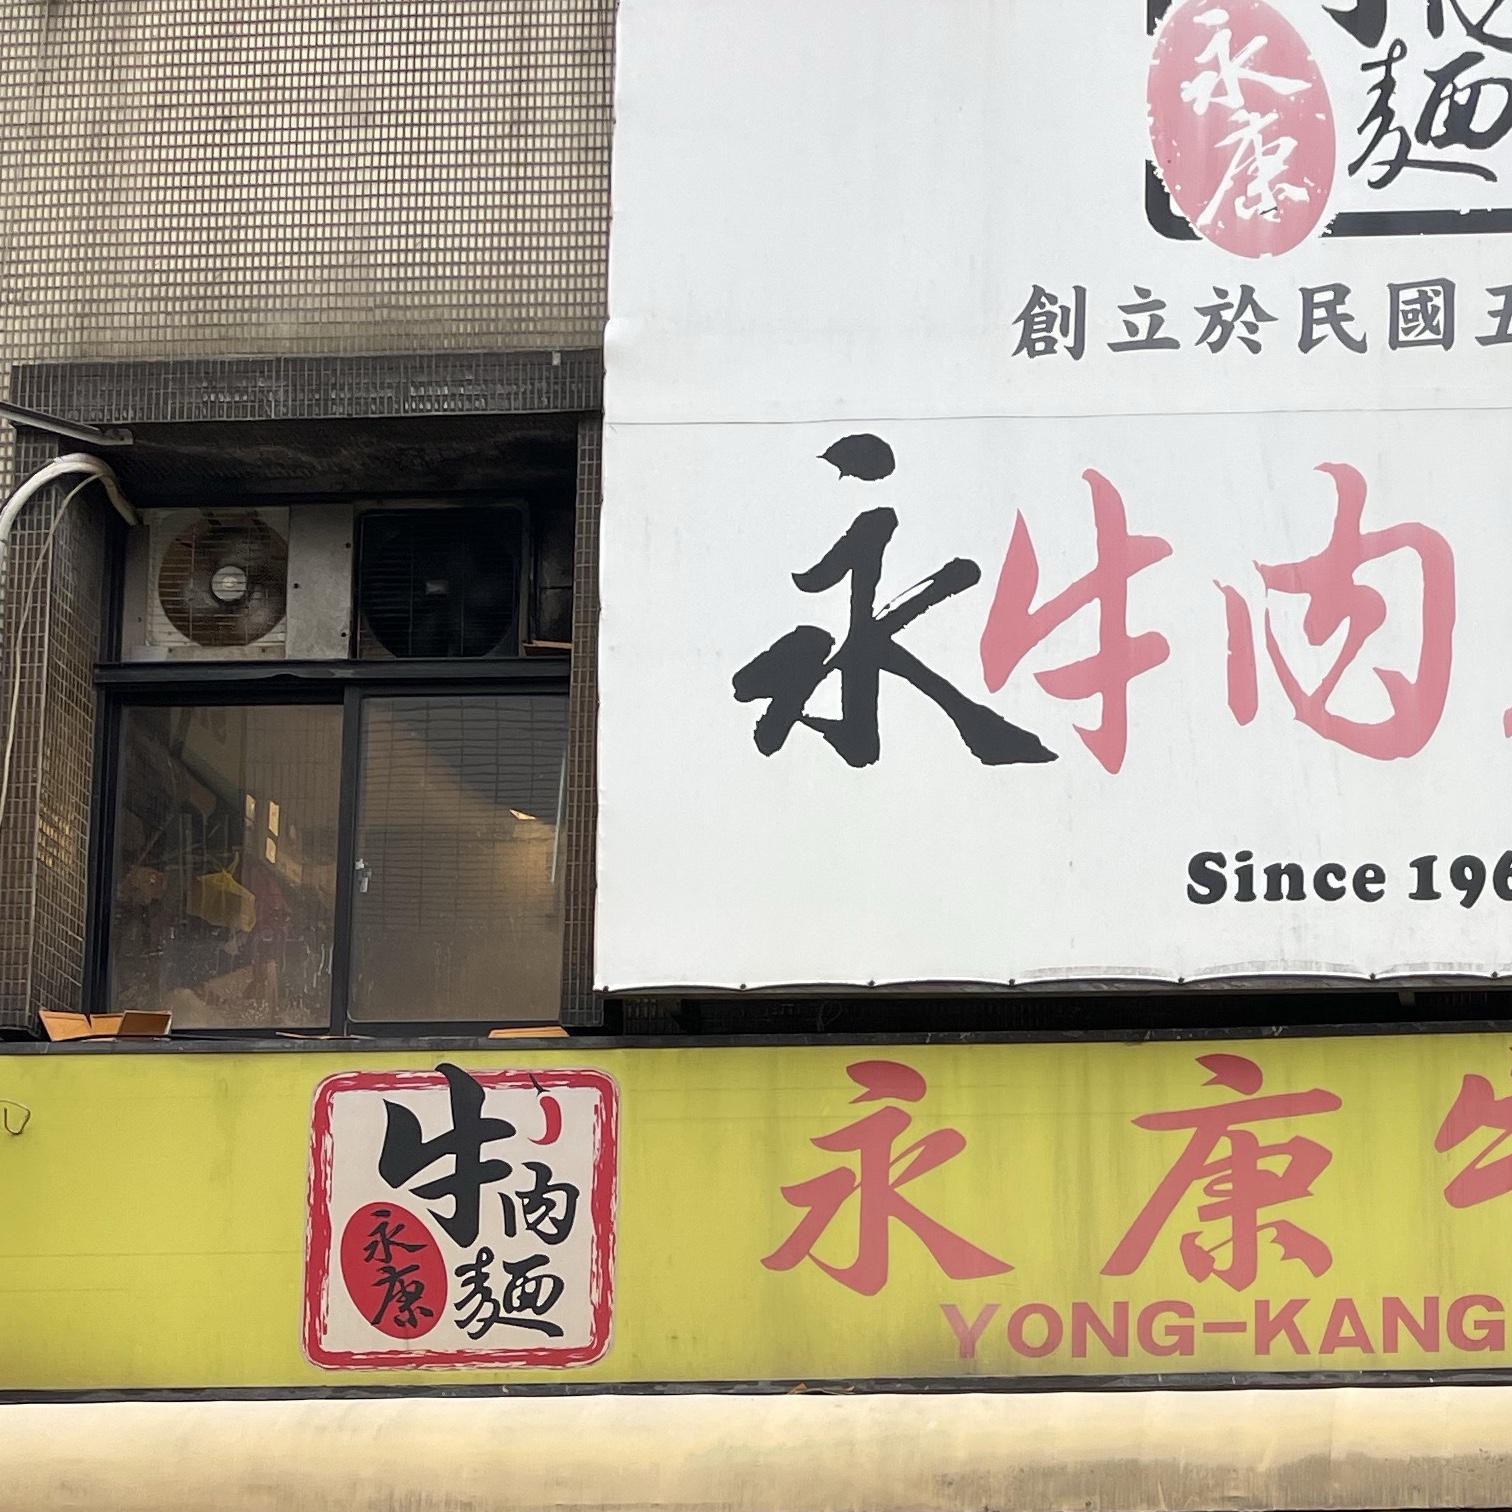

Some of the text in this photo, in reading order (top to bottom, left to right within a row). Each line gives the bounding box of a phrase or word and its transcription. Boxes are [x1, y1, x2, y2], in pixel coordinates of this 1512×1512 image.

[1186, 850, 1386, 905] Since
[363, 1209, 435, 1329] 永康
[942, 1293, 1506, 1360] YONG-KANG
